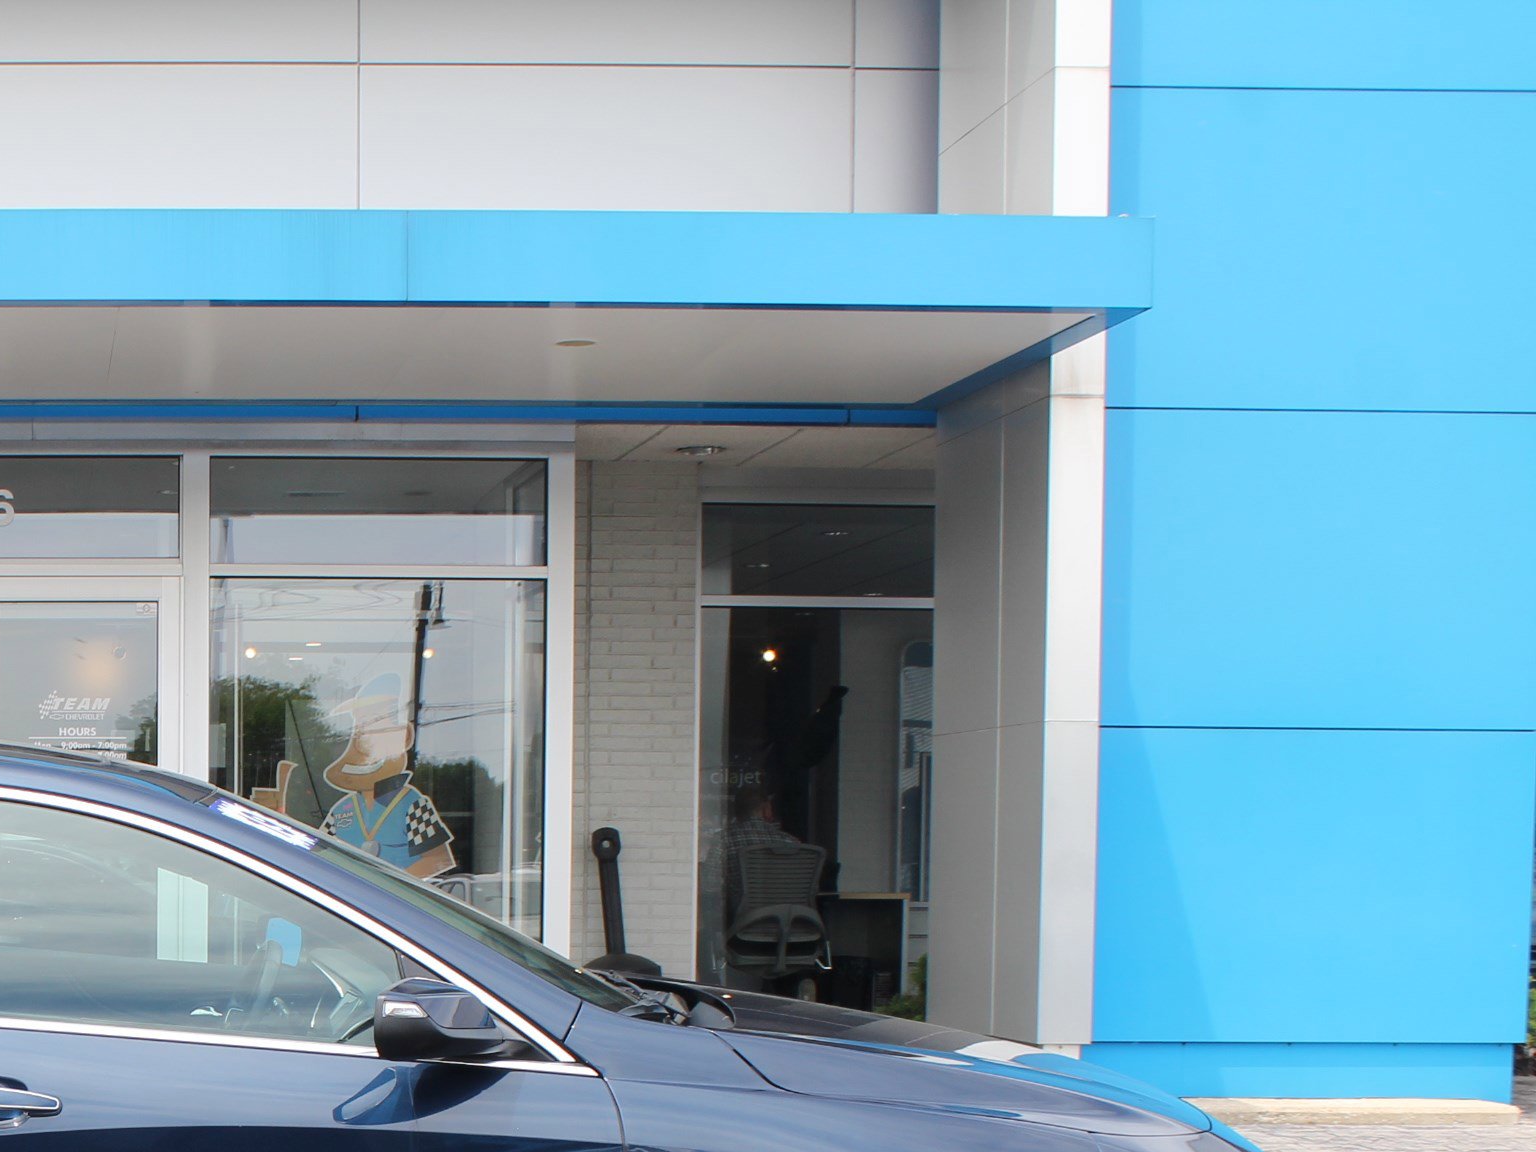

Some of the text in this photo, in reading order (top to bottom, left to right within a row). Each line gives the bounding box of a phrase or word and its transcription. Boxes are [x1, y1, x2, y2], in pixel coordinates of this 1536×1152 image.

[52, 697, 111, 710] TEAM
[65, 713, 104, 721] CHEVROLET
[59, 727, 97, 736] HOURS
[97, 741, 127, 751] 7:00pm
[710, 768, 761, 788] cilajet
